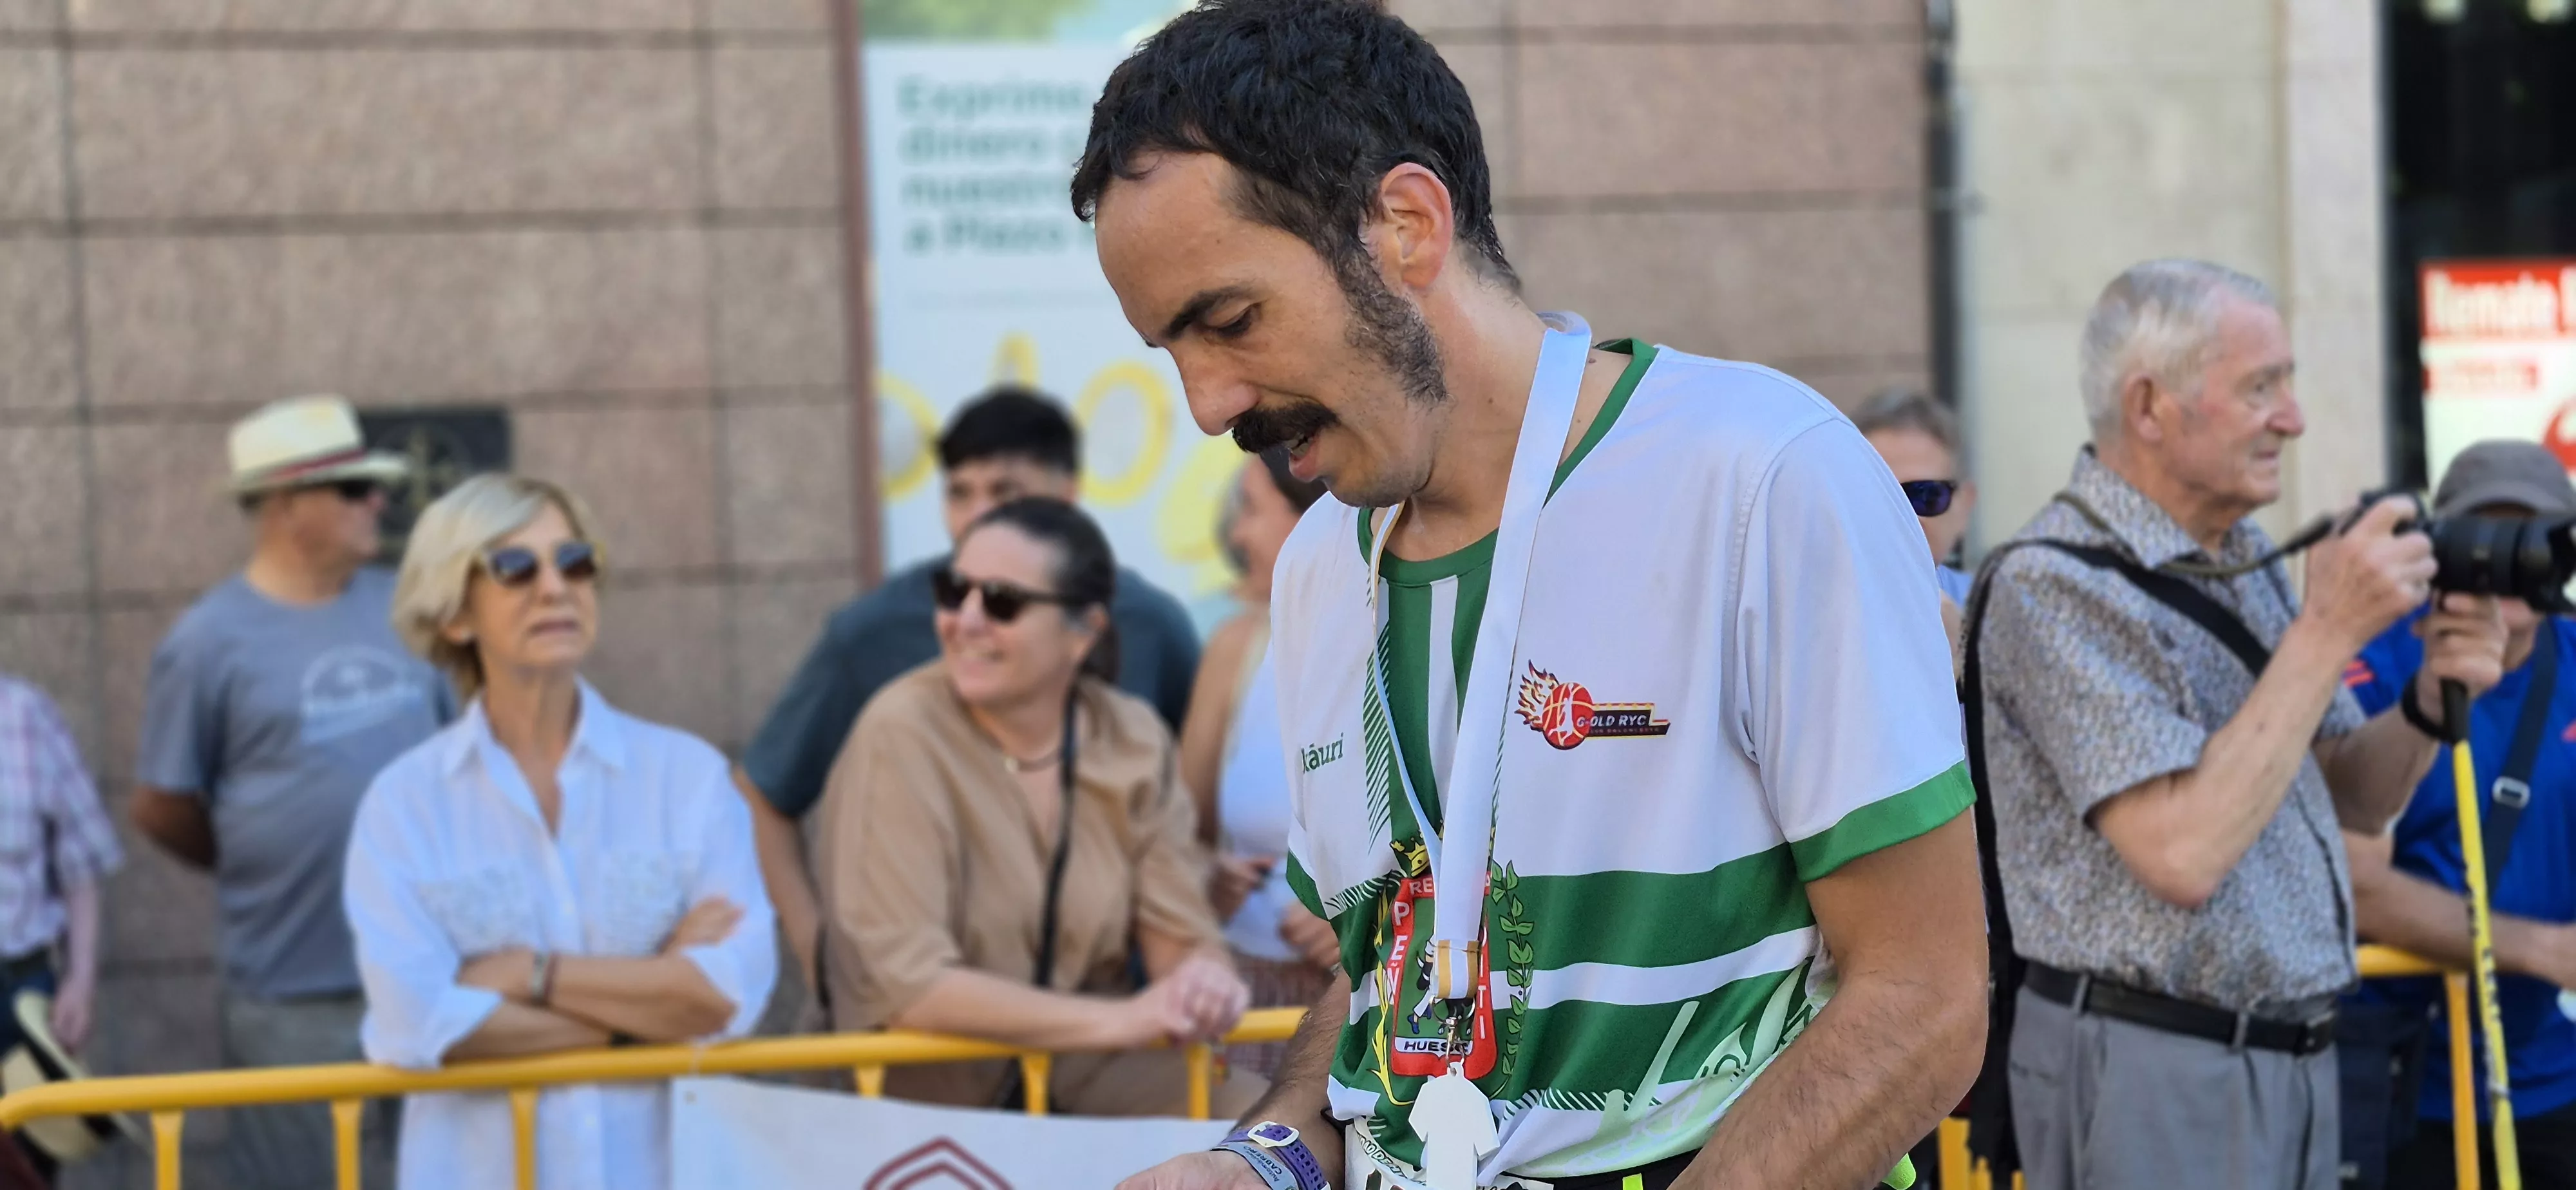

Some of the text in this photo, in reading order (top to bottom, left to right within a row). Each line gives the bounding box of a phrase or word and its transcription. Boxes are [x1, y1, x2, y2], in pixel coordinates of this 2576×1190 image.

[1618, 714, 1647, 726] RYC
[1387, 901, 1410, 1005] PEÑ
[1244, 1146, 1282, 1175] CABRERO
